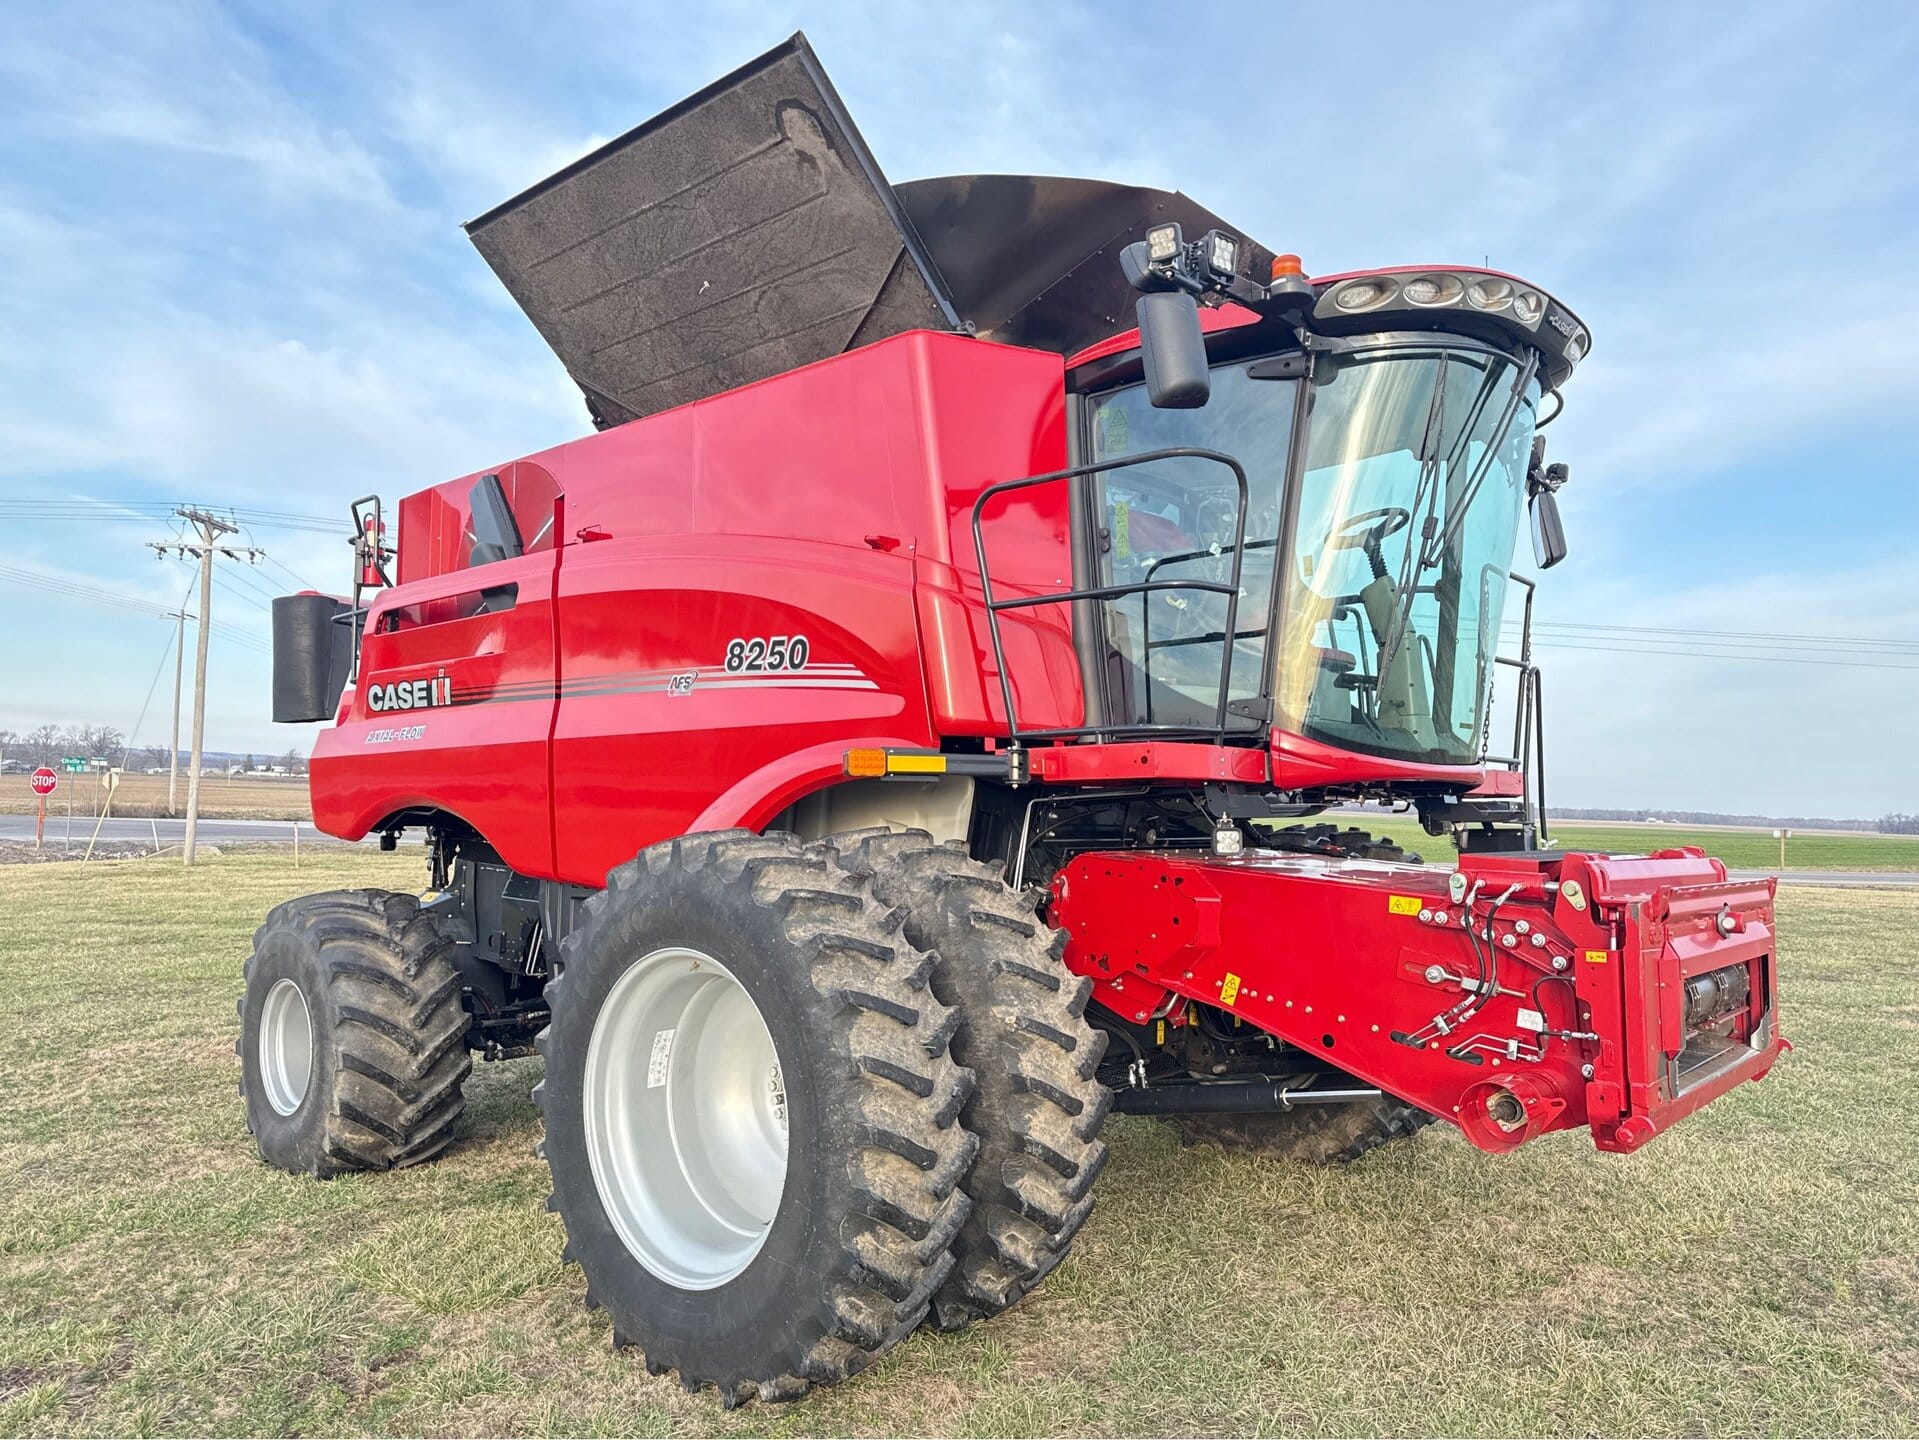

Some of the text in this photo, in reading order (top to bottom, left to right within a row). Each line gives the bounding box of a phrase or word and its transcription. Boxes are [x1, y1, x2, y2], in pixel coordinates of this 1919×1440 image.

[725, 635, 810, 673] 8250
[668, 674, 692, 690] AFS
[368, 680, 428, 712] CASE
[32, 775, 56, 787] STOP
